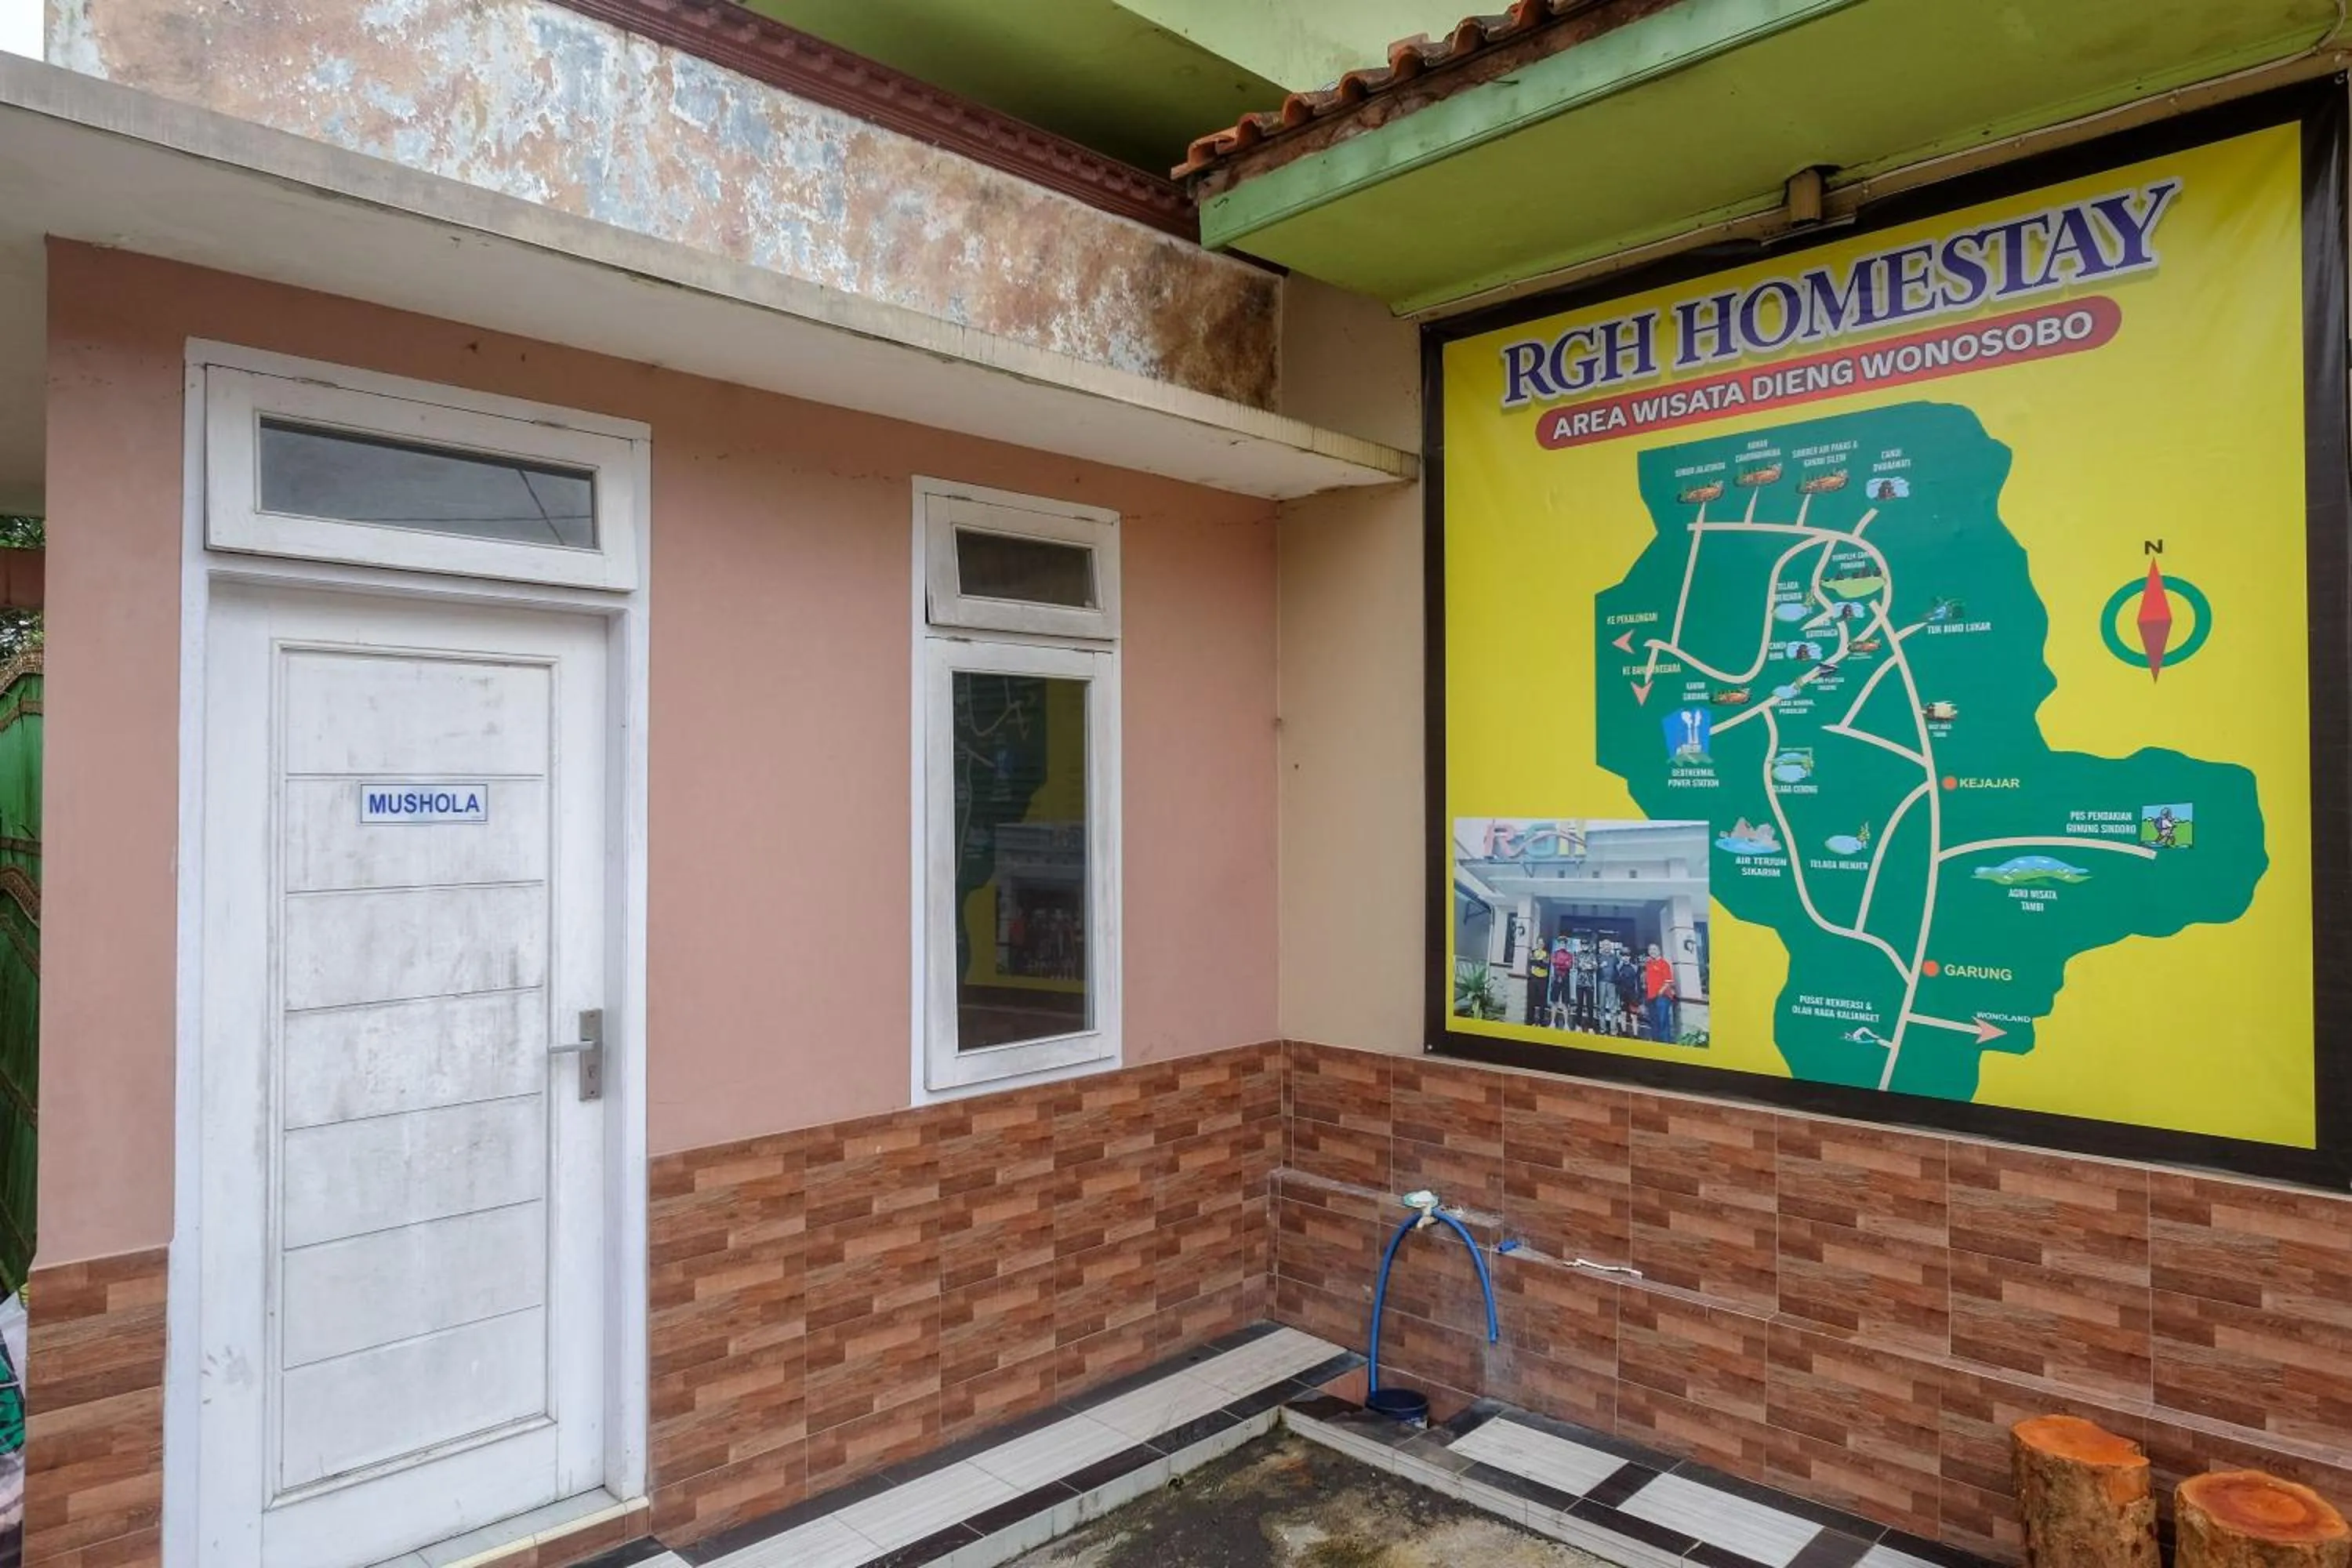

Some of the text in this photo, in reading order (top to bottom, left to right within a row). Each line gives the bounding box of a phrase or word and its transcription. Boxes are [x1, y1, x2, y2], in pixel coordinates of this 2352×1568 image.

[1504, 182, 2176, 405] RGH HOMESTAY
[1552, 310, 2093, 441] AREA WISATA DIENG WONOSOBO
[2144, 539, 2163, 555] N
[1959, 778, 2020, 789] KEJAJAR
[368, 793, 481, 814] MUSHOLA
[2070, 811, 2132, 822] POS PENDAKIAN
[2066, 823, 2137, 834] GUNUNG SINDORO
[1735, 855, 1751, 865] AIR
[2009, 888, 2028, 898] AGRO
[2021, 901, 2044, 912] TAMBI
[1944, 964, 2013, 981] GARUNG
[1799, 995, 1824, 1007] PUSAT
[1825, 998, 1864, 1011] REKREASI
[1791, 1005, 1813, 1016] OLAH
